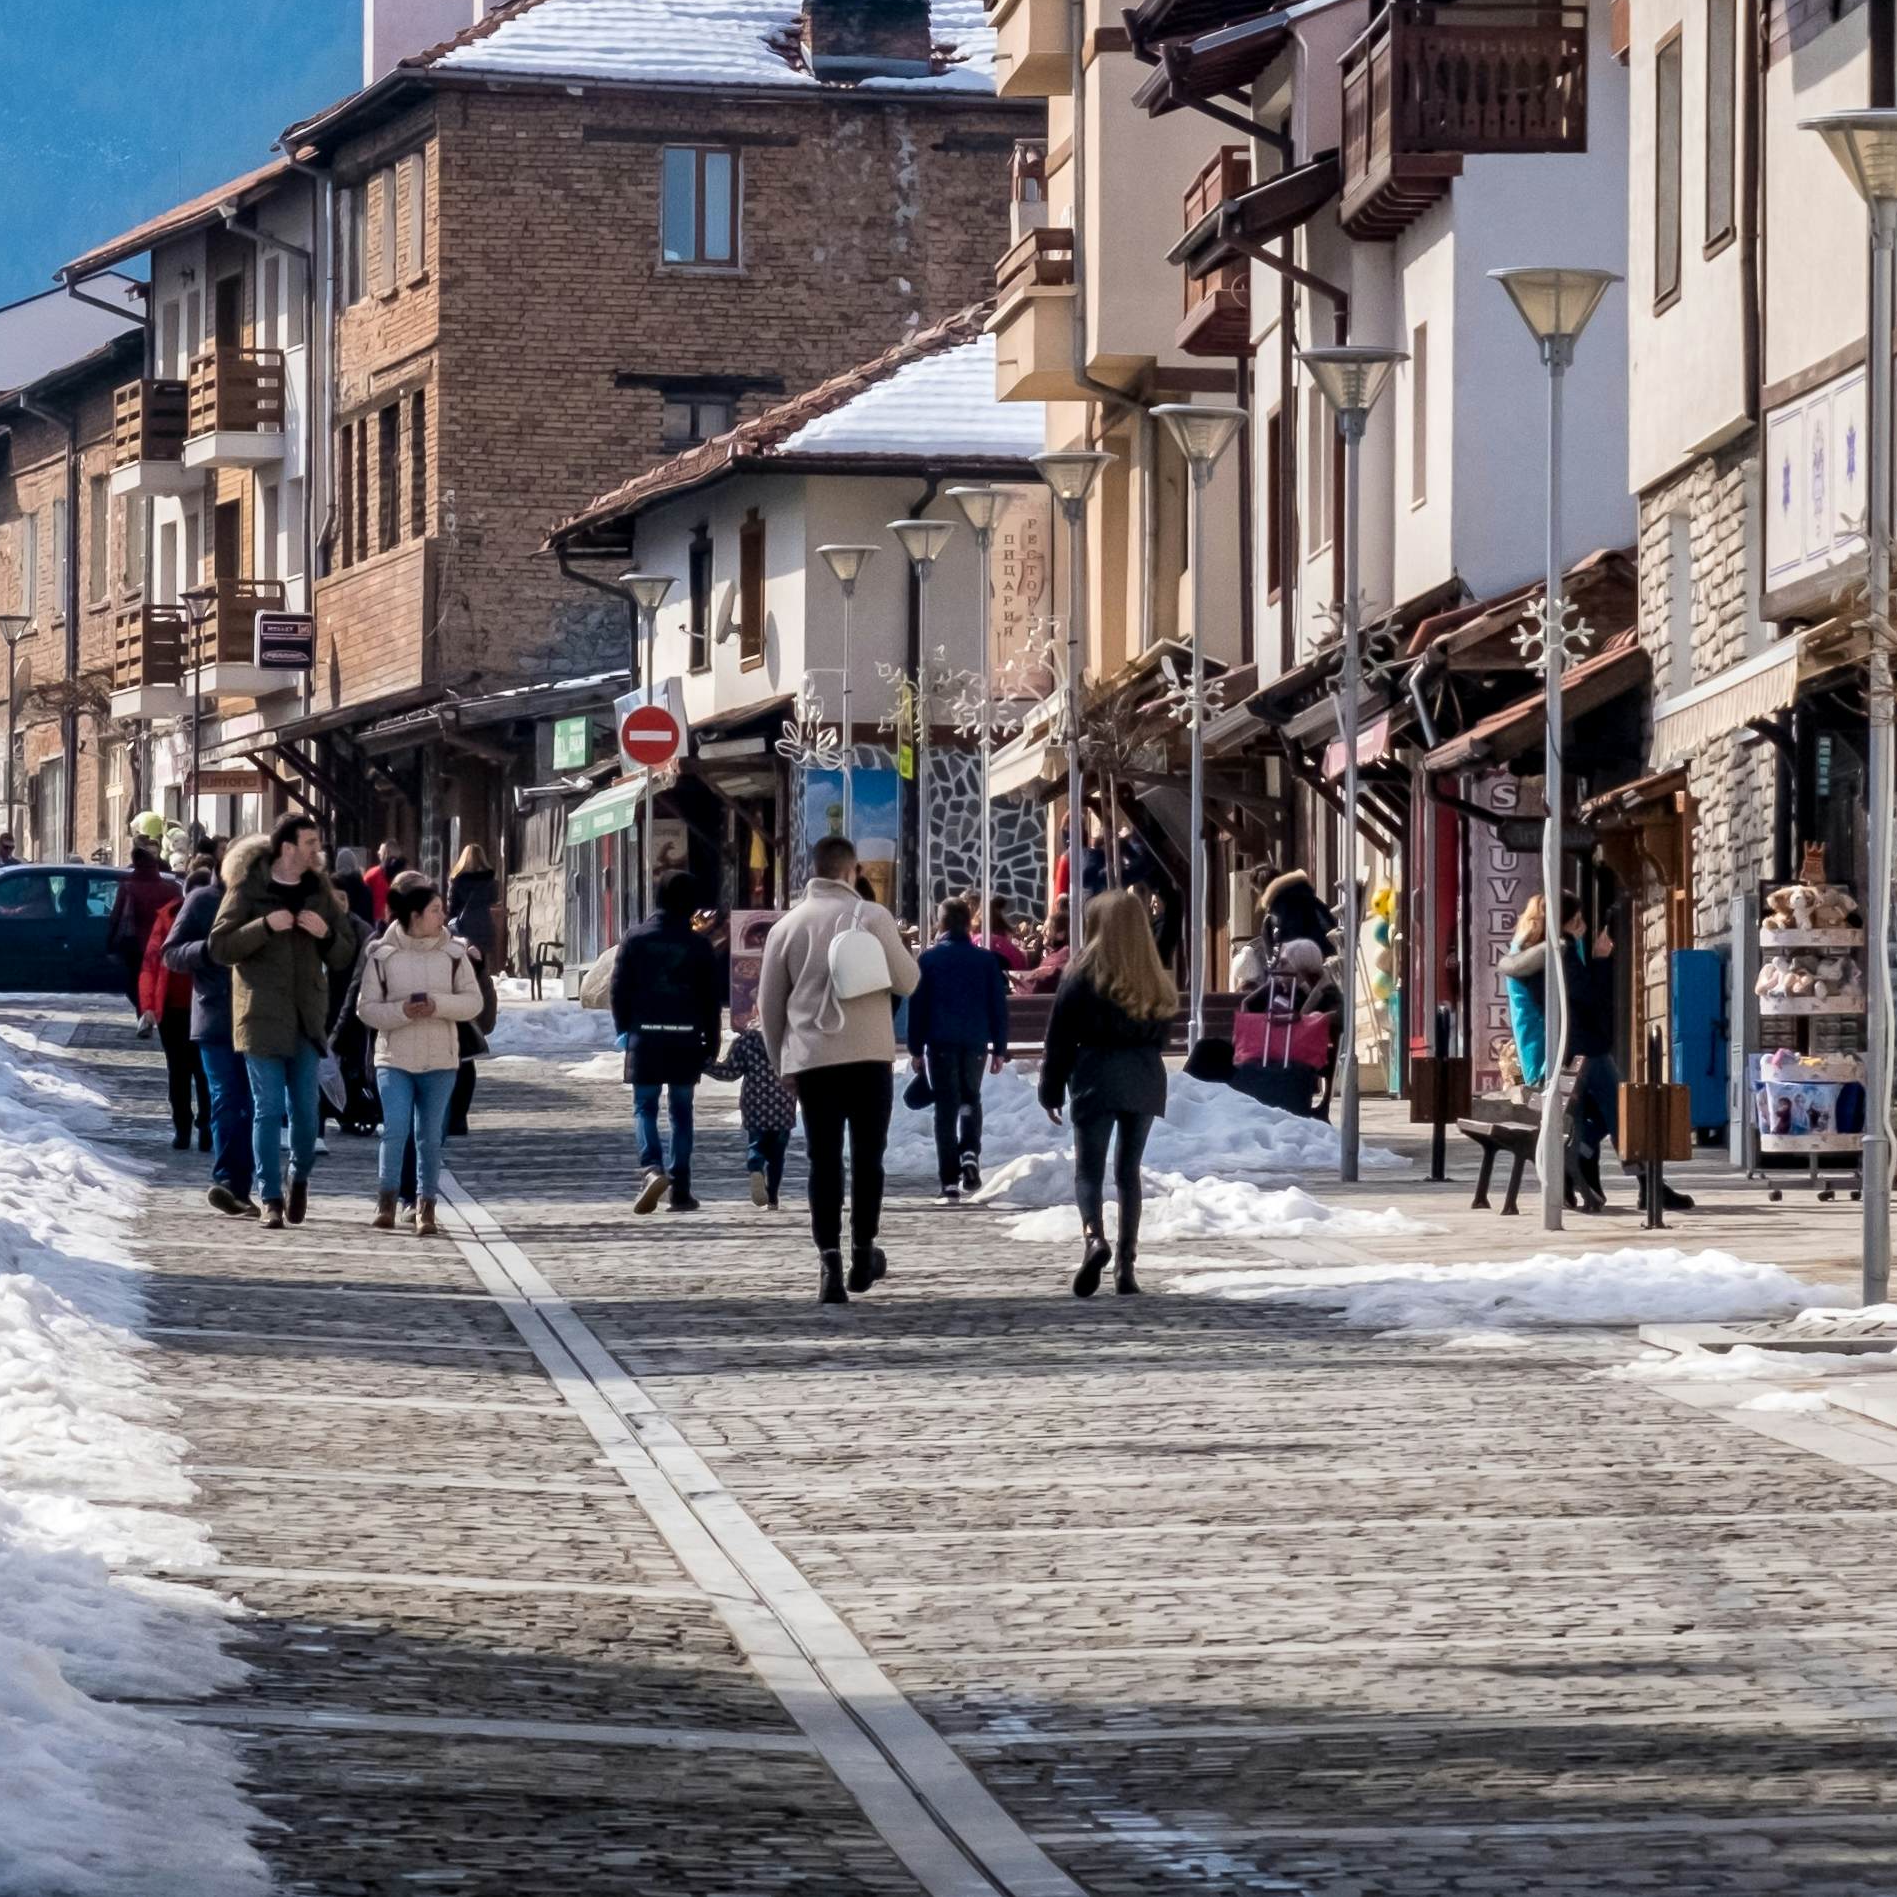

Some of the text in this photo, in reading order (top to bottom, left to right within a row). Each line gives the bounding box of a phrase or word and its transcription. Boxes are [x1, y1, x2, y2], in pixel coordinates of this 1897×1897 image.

[1003, 534, 1015, 637] ПИЦАРИЯ
[1027, 519, 1041, 652] РЕСТОРА
[1488, 783, 1519, 1061] SUVENIRS
